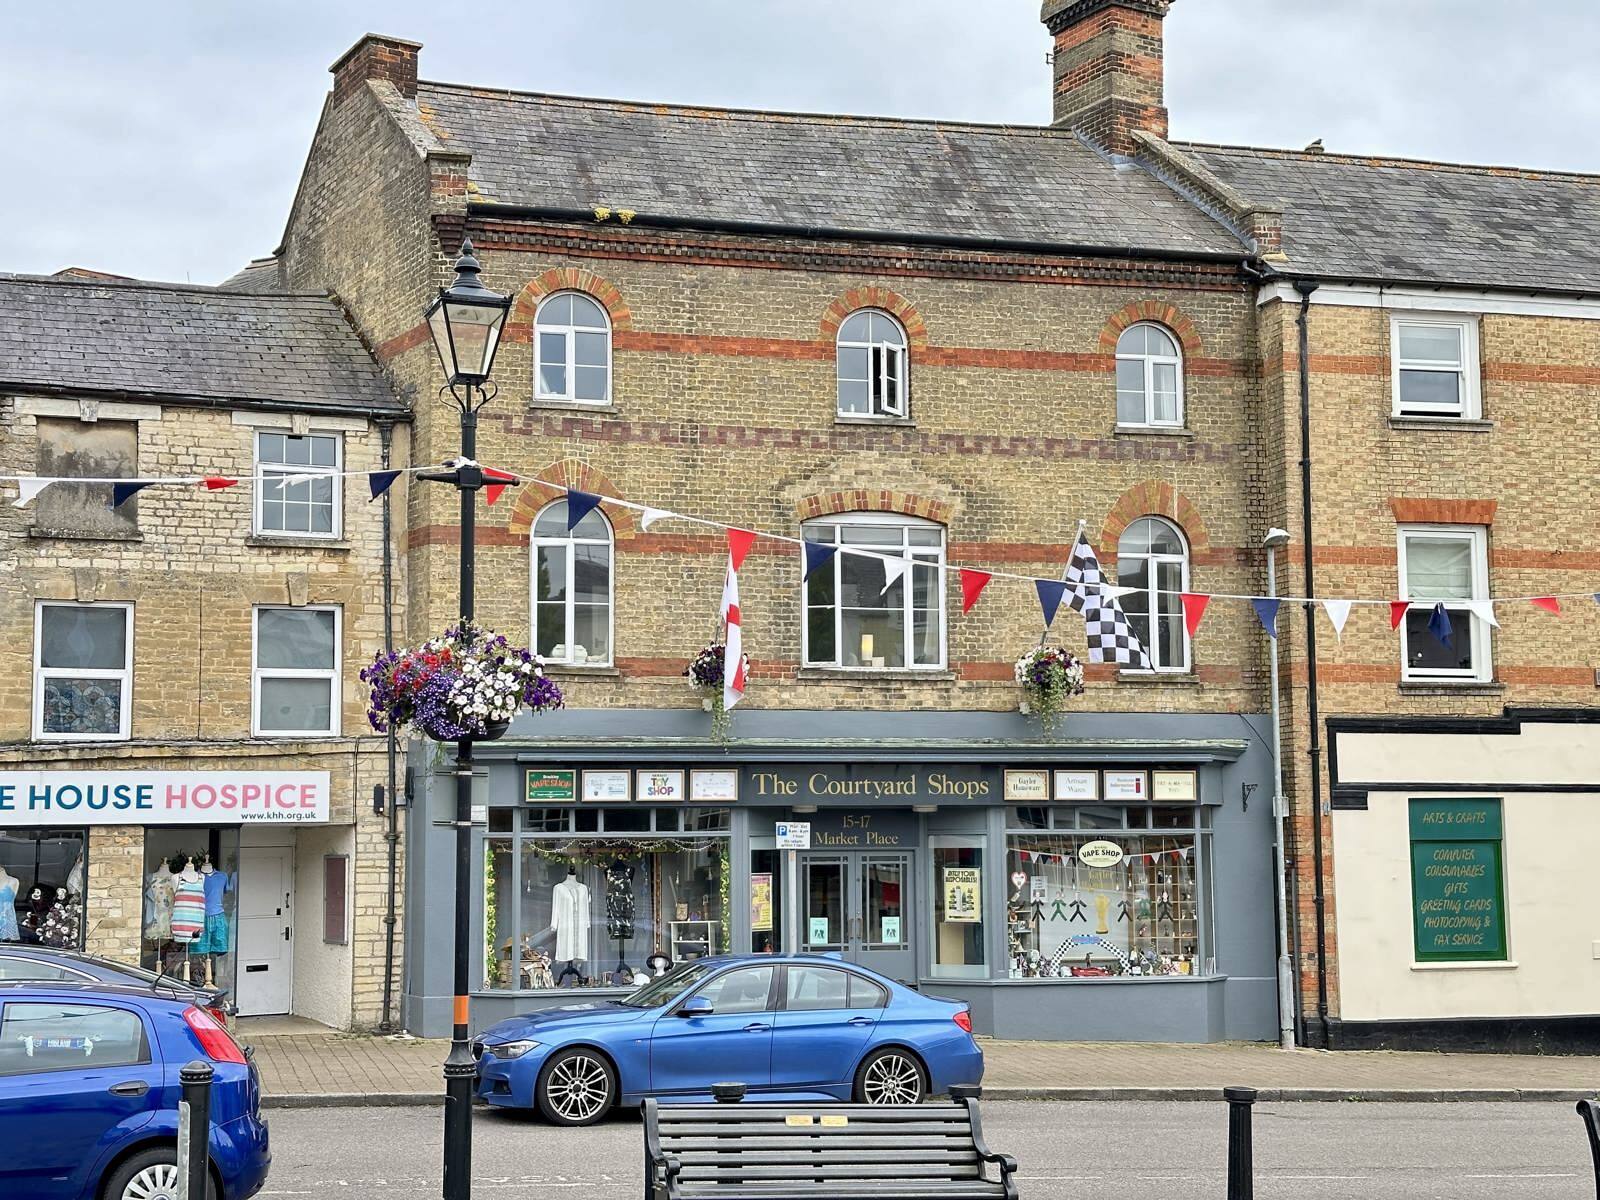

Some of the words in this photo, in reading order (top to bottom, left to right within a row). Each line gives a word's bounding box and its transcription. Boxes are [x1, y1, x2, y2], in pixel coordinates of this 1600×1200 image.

[650, 777, 669, 786] TOY
[751, 772, 798, 795] The
[808, 772, 917, 799] Courtyard
[927, 773, 989, 799] Shops
[28, 784, 154, 811] HOUSE
[165, 783, 317, 809] HOSPICE
[647, 786, 674, 796] SHOP
[240, 811, 317, 821] www.khh.org.uk
[843, 814, 871, 829] 15-17
[1422, 811, 1445, 824] ARTS
[1446, 811, 1454, 824] &
[1455, 811, 1487, 824] CRAFTS
[815, 831, 858, 845] Market
[866, 831, 899, 845] Place
[1081, 849, 1100, 858] VAPE
[1101, 849, 1121, 858] SHOP
[1433, 848, 1475, 861] COMPUTER
[1425, 864, 1486, 877] CONSUMABLES
[1444, 882, 1469, 896] GIFTS
[1420, 899, 1461, 914] GREETING
[1464, 899, 1492, 911] CARDS
[1424, 916, 1481, 931] PHOTOCOPYING
[1484, 915, 1491, 928] &
[1434, 934, 1450, 946] FAX
[1451, 933, 1485, 946] SERVICE
